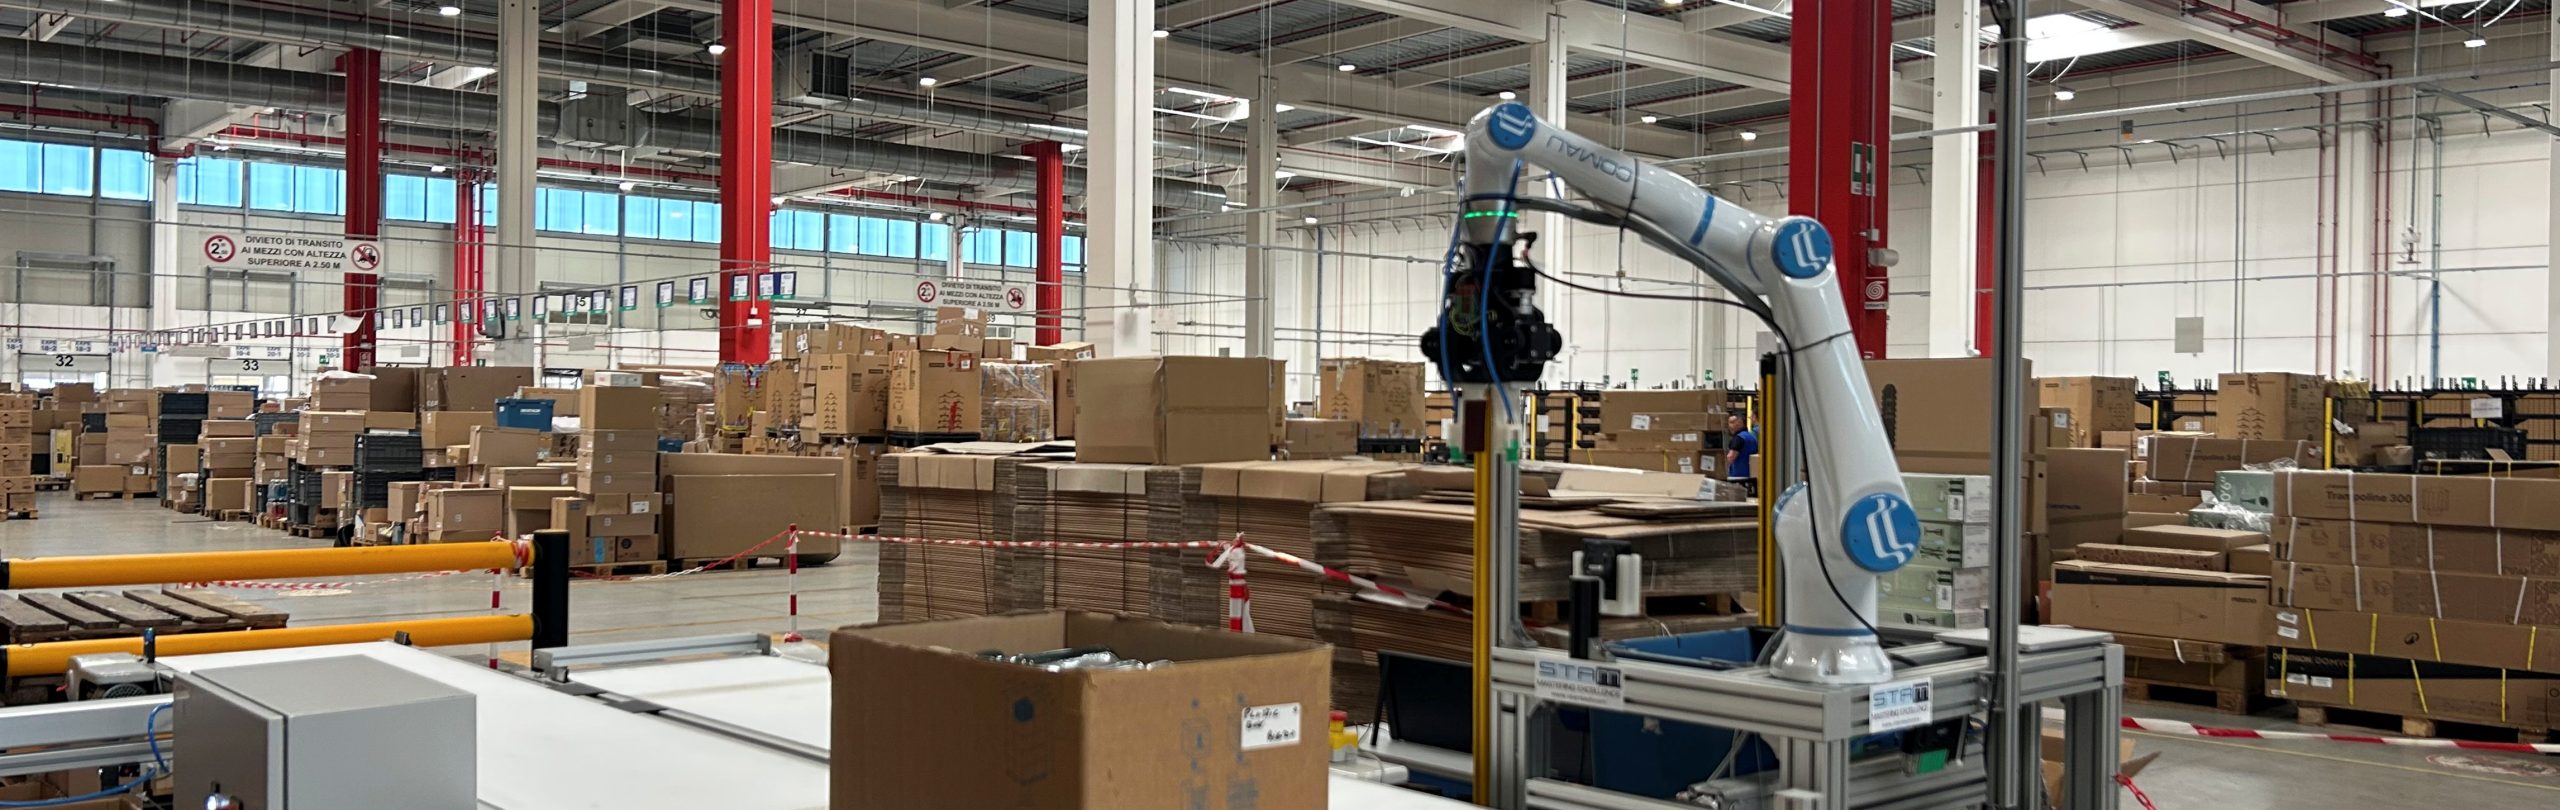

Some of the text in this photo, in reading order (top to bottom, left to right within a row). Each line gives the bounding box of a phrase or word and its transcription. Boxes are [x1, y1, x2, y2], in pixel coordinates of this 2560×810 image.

[1546, 135, 1632, 182] COMAU
[245, 235, 343, 248] DIVIETO DI TRANSITO
[241, 246, 347, 259] AI MEZZI CON ALTEZZA
[248, 257, 302, 268] SUPERIORE
[304, 260, 311, 268] A
[312, 261, 331, 269] 2.50
[973, 284, 1002, 292] TRANSITO
[56, 355, 74, 367] 32
[242, 360, 259, 371] 33
[2390, 493, 2413, 503] 300
[1539, 660, 1621, 688] STAM
[1873, 682, 1928, 706] STAM
